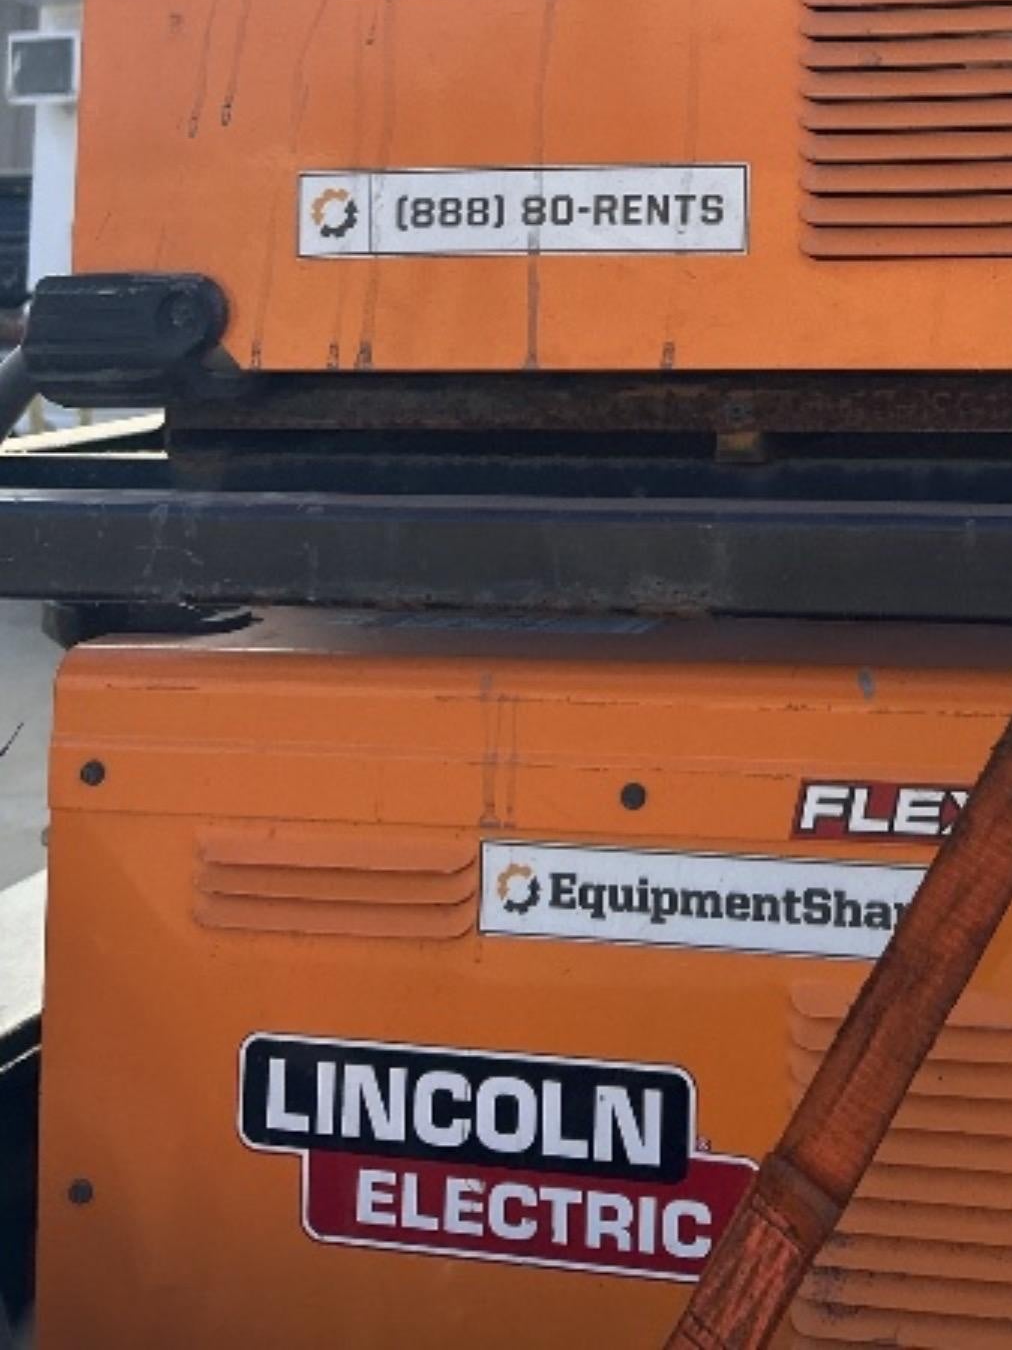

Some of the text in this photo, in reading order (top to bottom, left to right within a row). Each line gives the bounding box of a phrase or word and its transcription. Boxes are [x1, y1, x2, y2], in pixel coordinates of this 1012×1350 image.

[396, 193, 724, 230] (888) 80-RENTS
[547, 872, 905, 932] EquipmentSha
[266, 1058, 662, 1167] LINCOLN
[355, 1167, 712, 1259] ELECTRIC
